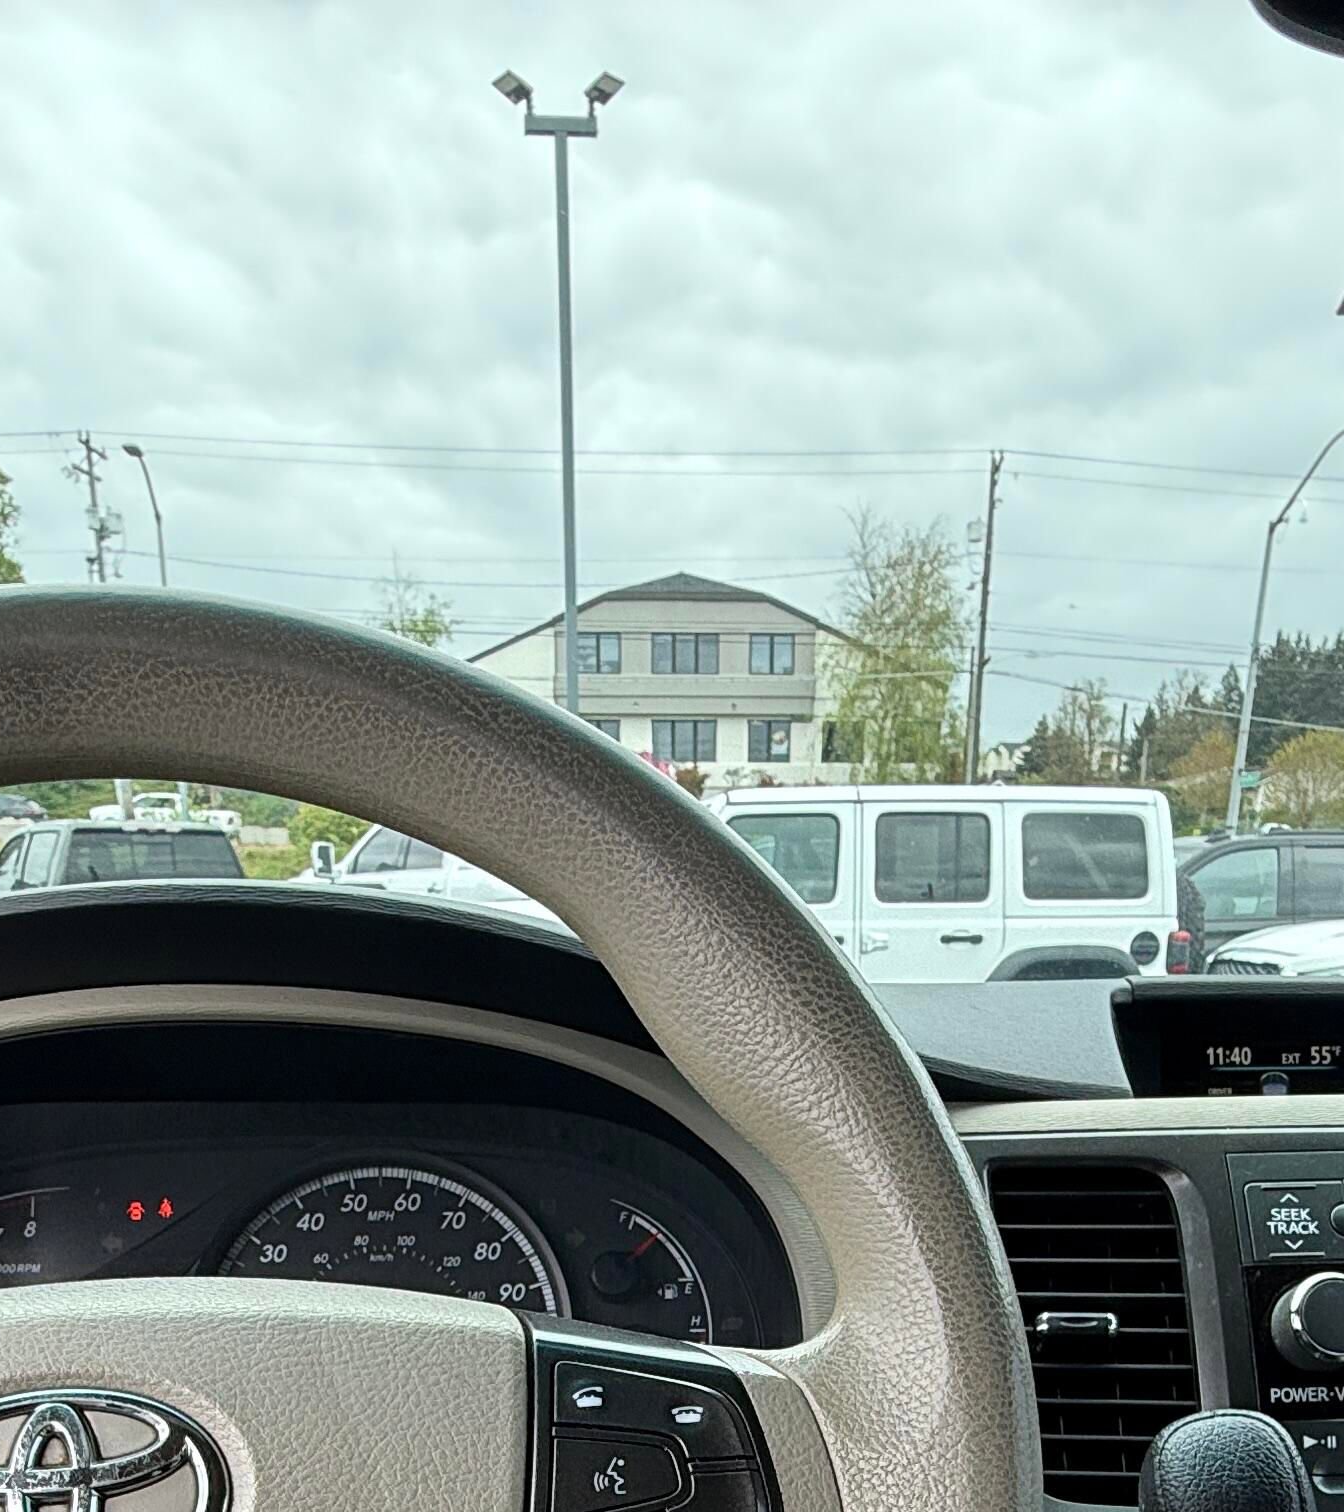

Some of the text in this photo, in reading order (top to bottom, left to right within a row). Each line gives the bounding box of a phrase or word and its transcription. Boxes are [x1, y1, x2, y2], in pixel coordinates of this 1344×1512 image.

[1206, 1046, 1253, 1066] 11:40
[1281, 1053, 1301, 1065] EXT
[340, 1194, 368, 1212] 50
[393, 1193, 422, 1212] 60
[367, 1211, 395, 1222] MPH
[439, 1211, 467, 1230] 70
[619, 1211, 629, 1223] F
[1270, 1207, 1311, 1221] SEEK
[23, 1220, 38, 1238] 8
[296, 1213, 325, 1231] 40
[1267, 1221, 1319, 1235] TRACK
[353, 1235, 370, 1247] 80
[396, 1235, 416, 1247] 100
[259, 1244, 288, 1263] 30
[312, 1252, 329, 1265] 60
[369, 1252, 394, 1263] km/h
[473, 1242, 502, 1261] 80
[442, 1256, 461, 1267] 120
[499, 1283, 527, 1303] 90
[684, 1283, 694, 1295] E
[690, 1315, 702, 1327] H
